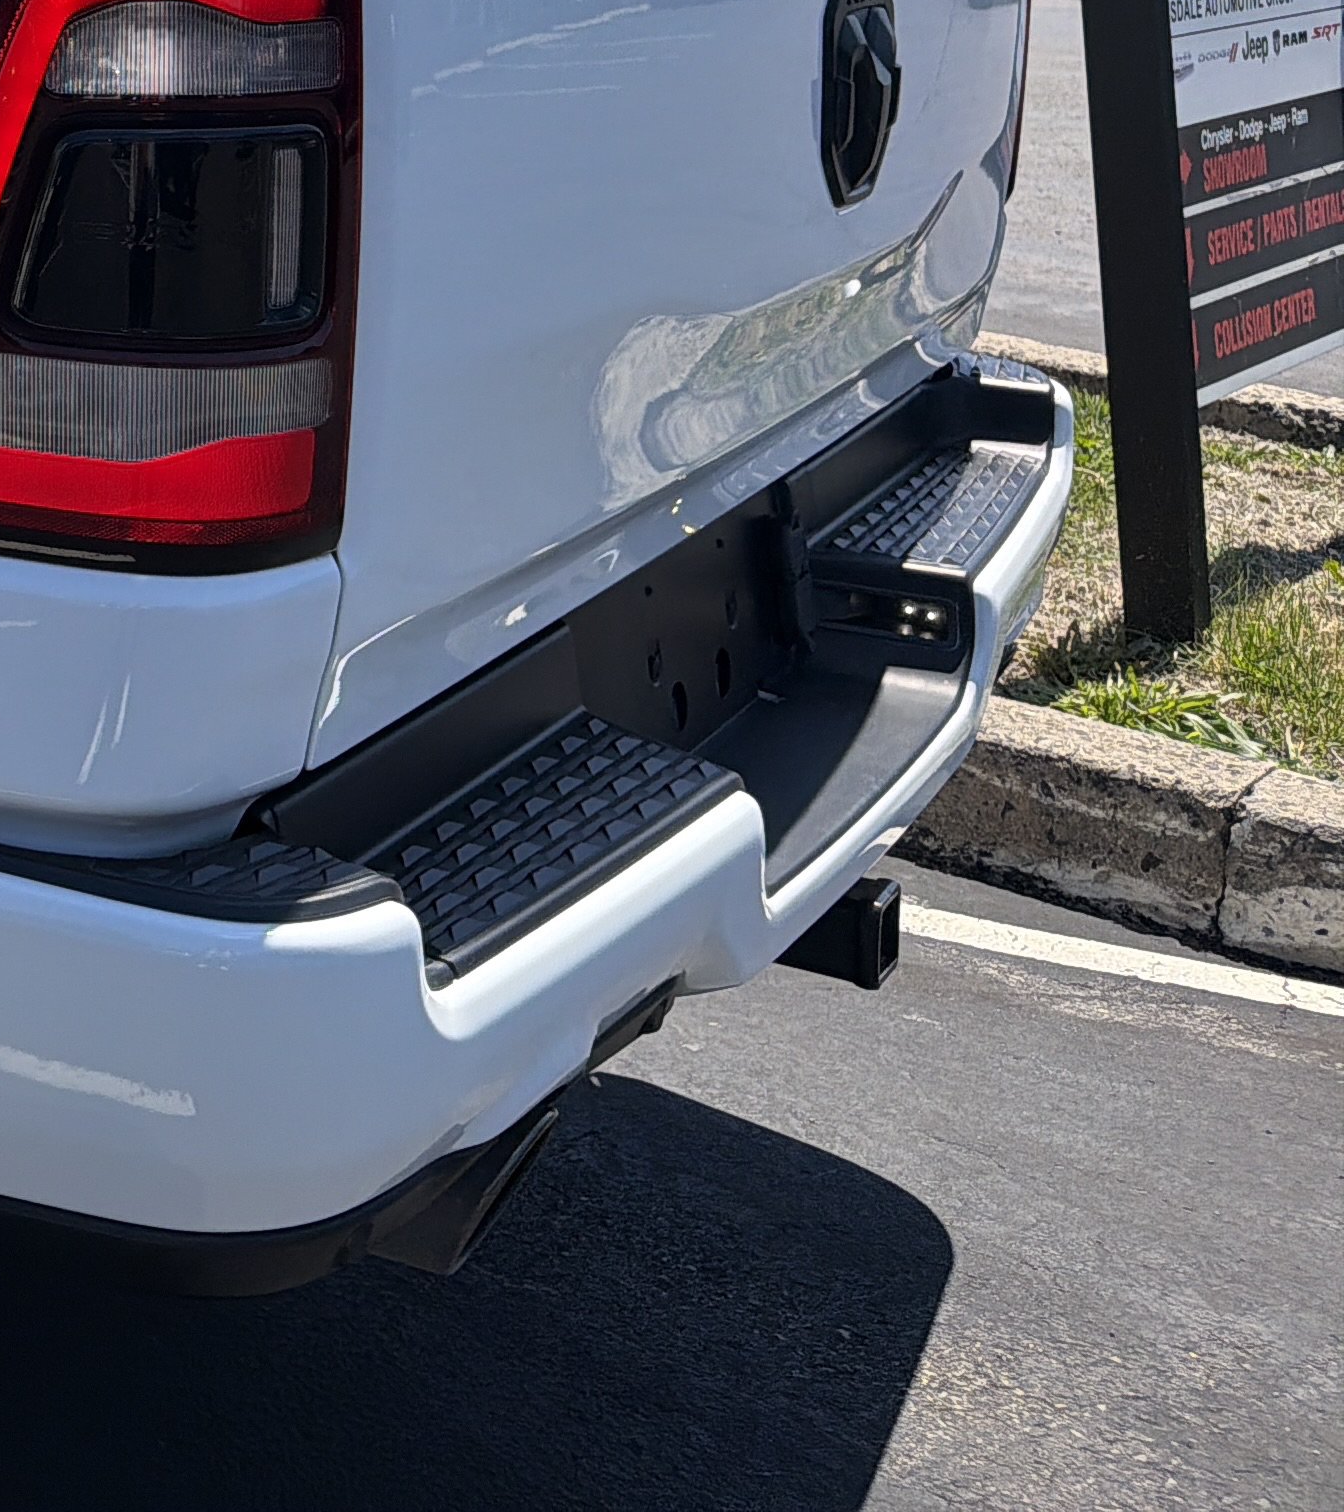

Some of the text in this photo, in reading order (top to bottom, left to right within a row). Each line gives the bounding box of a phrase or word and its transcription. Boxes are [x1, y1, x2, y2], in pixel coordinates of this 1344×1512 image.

[1241, 30, 1269, 64] Jeep
[1282, 31, 1308, 48] RAM
[1311, 24, 1341, 41] SRT
[1201, 107, 1309, 152] Chrysler Dodge Jeep Ram
[1203, 143, 1268, 193] SHOWROOM
[1207, 218, 1255, 265] SERVICE
[1263, 205, 1297, 246] PARTS
[1214, 288, 1317, 359] COLLISION CENTER
